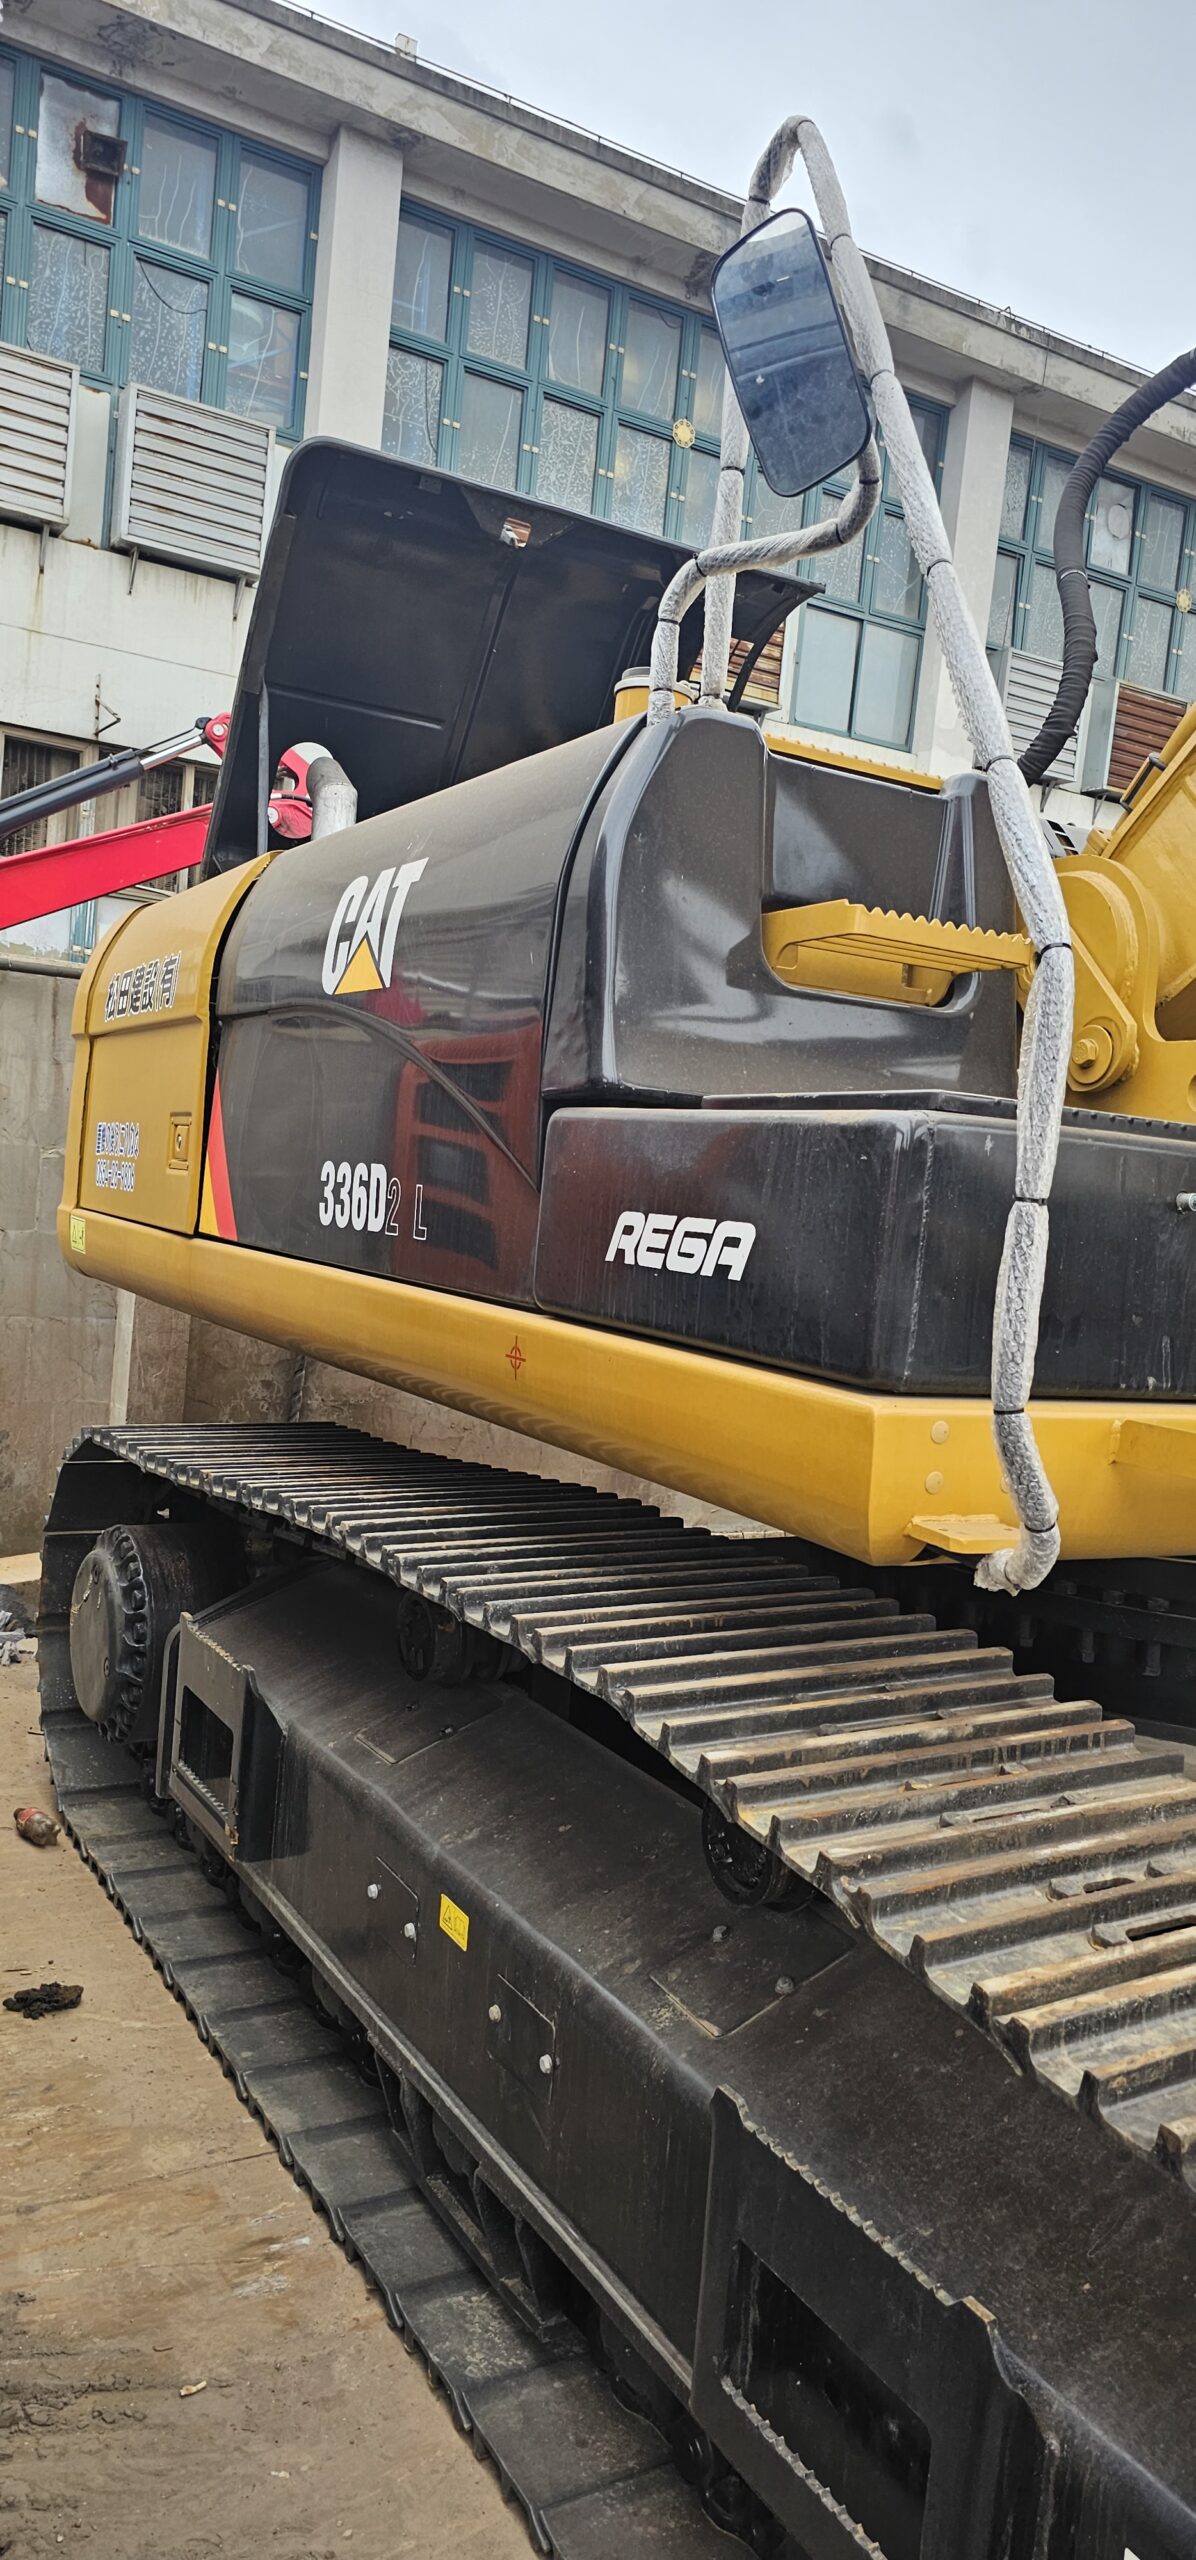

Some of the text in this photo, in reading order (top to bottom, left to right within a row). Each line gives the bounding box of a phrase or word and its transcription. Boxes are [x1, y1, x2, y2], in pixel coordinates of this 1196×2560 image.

[321, 857, 429, 995] CAT
[412, 1184, 428, 1242] L
[605, 1210, 757, 1282] REGA
